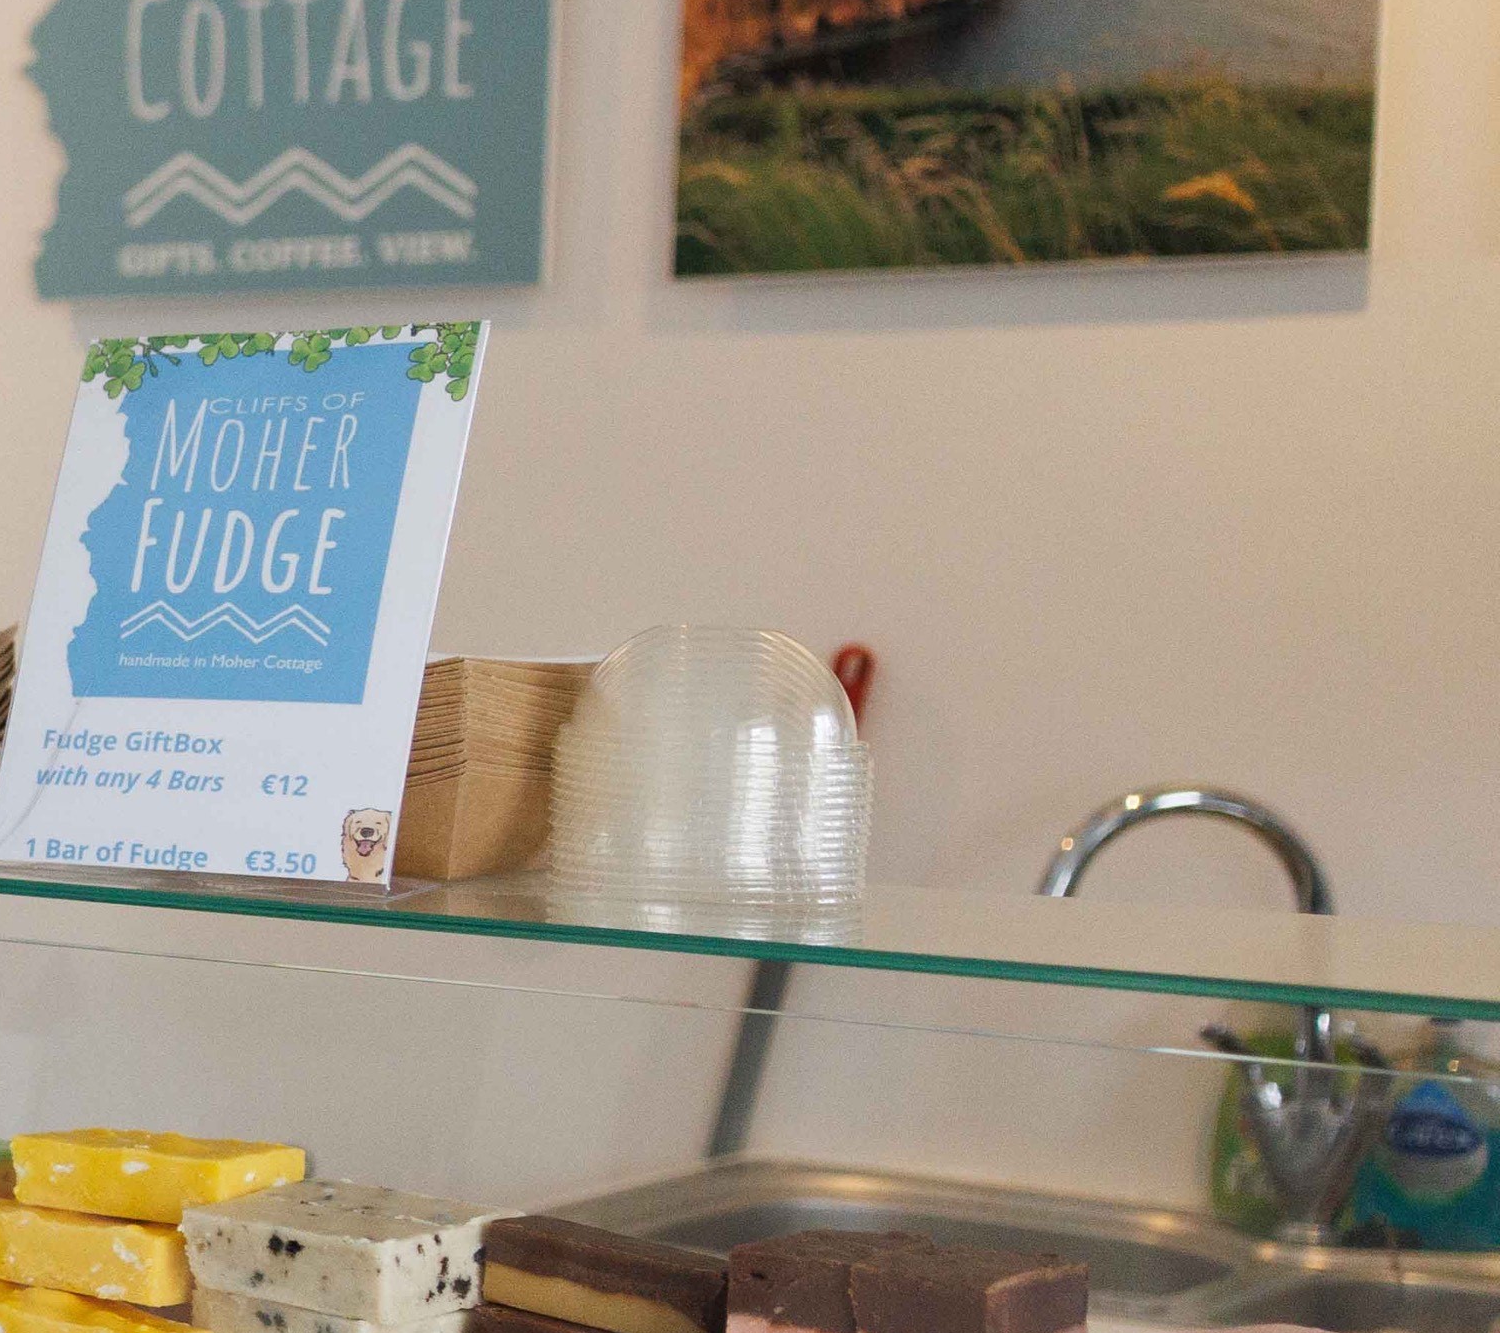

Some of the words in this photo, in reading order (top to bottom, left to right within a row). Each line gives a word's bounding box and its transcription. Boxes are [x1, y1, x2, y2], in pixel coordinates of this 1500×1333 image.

[207, 395, 309, 417] CLIFFS
[322, 391, 366, 409] OF
[150, 397, 360, 494] MOHER
[129, 497, 348, 596] FUDGE
[117, 653, 191, 668] handmade
[194, 655, 206, 668] in
[211, 655, 259, 669] Moher
[263, 655, 324, 674] Cottage
[42, 728, 119, 756] Fudge
[125, 730, 224, 756] GiftBox
[36, 765, 88, 787] with
[94, 771, 141, 794] any
[145, 769, 163, 789] 4
[167, 770, 224, 793] Bars
[260, 773, 310, 797] €12
[25, 837, 37, 858] 1
[45, 838, 89, 861] Bar
[96, 840, 124, 863] of
[129, 842, 209, 872] Fudge
[245, 850, 318, 876] €3.50
